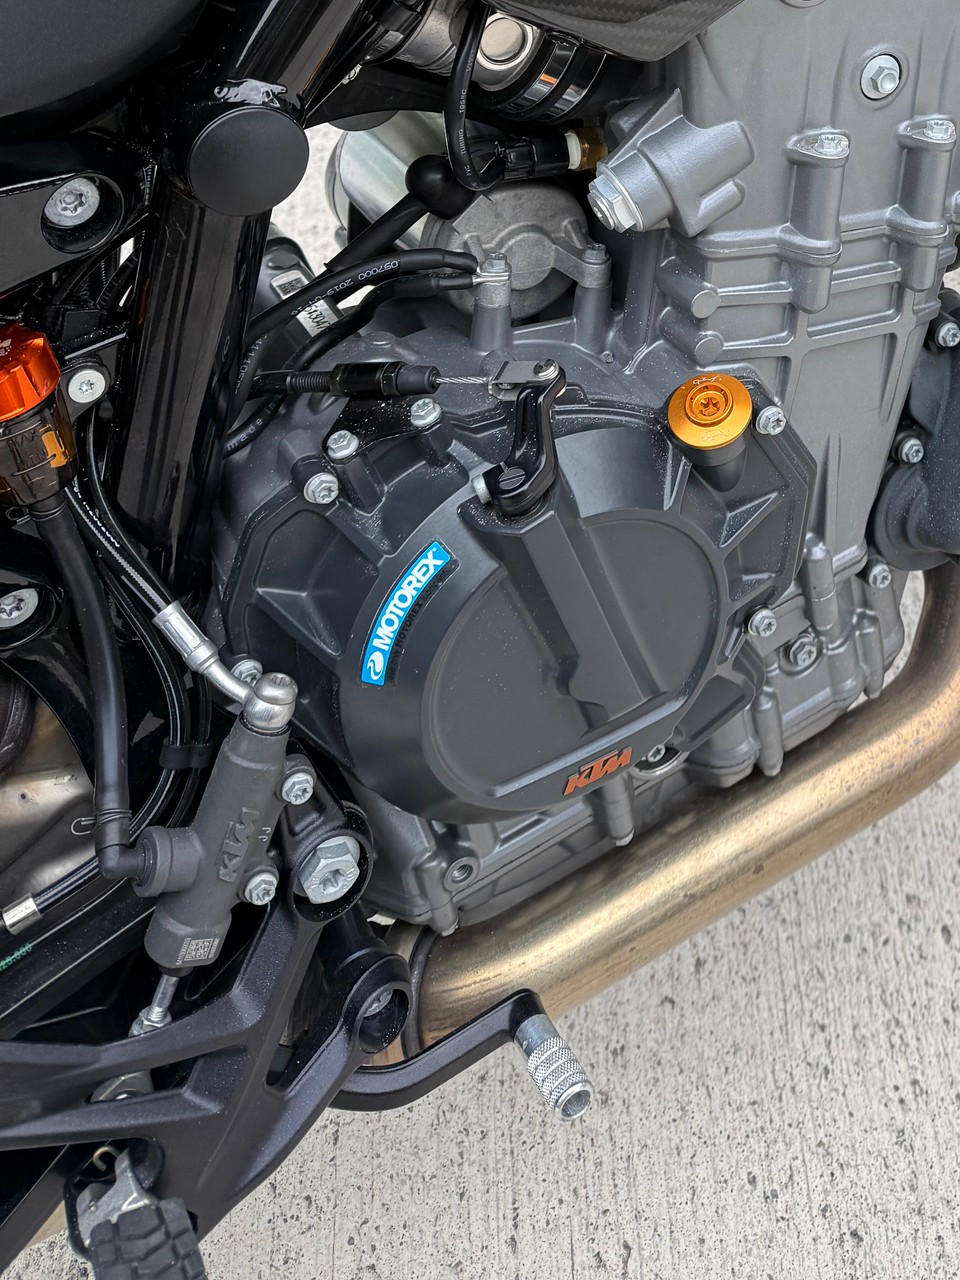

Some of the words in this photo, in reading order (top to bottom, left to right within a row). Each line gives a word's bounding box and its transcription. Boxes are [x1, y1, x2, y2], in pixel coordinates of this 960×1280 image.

[371, 548, 444, 652] MOTOREX
[397, 601, 424, 648] MOTOREX
[562, 746, 633, 796] KTM
[218, 806, 261, 883] KTM
